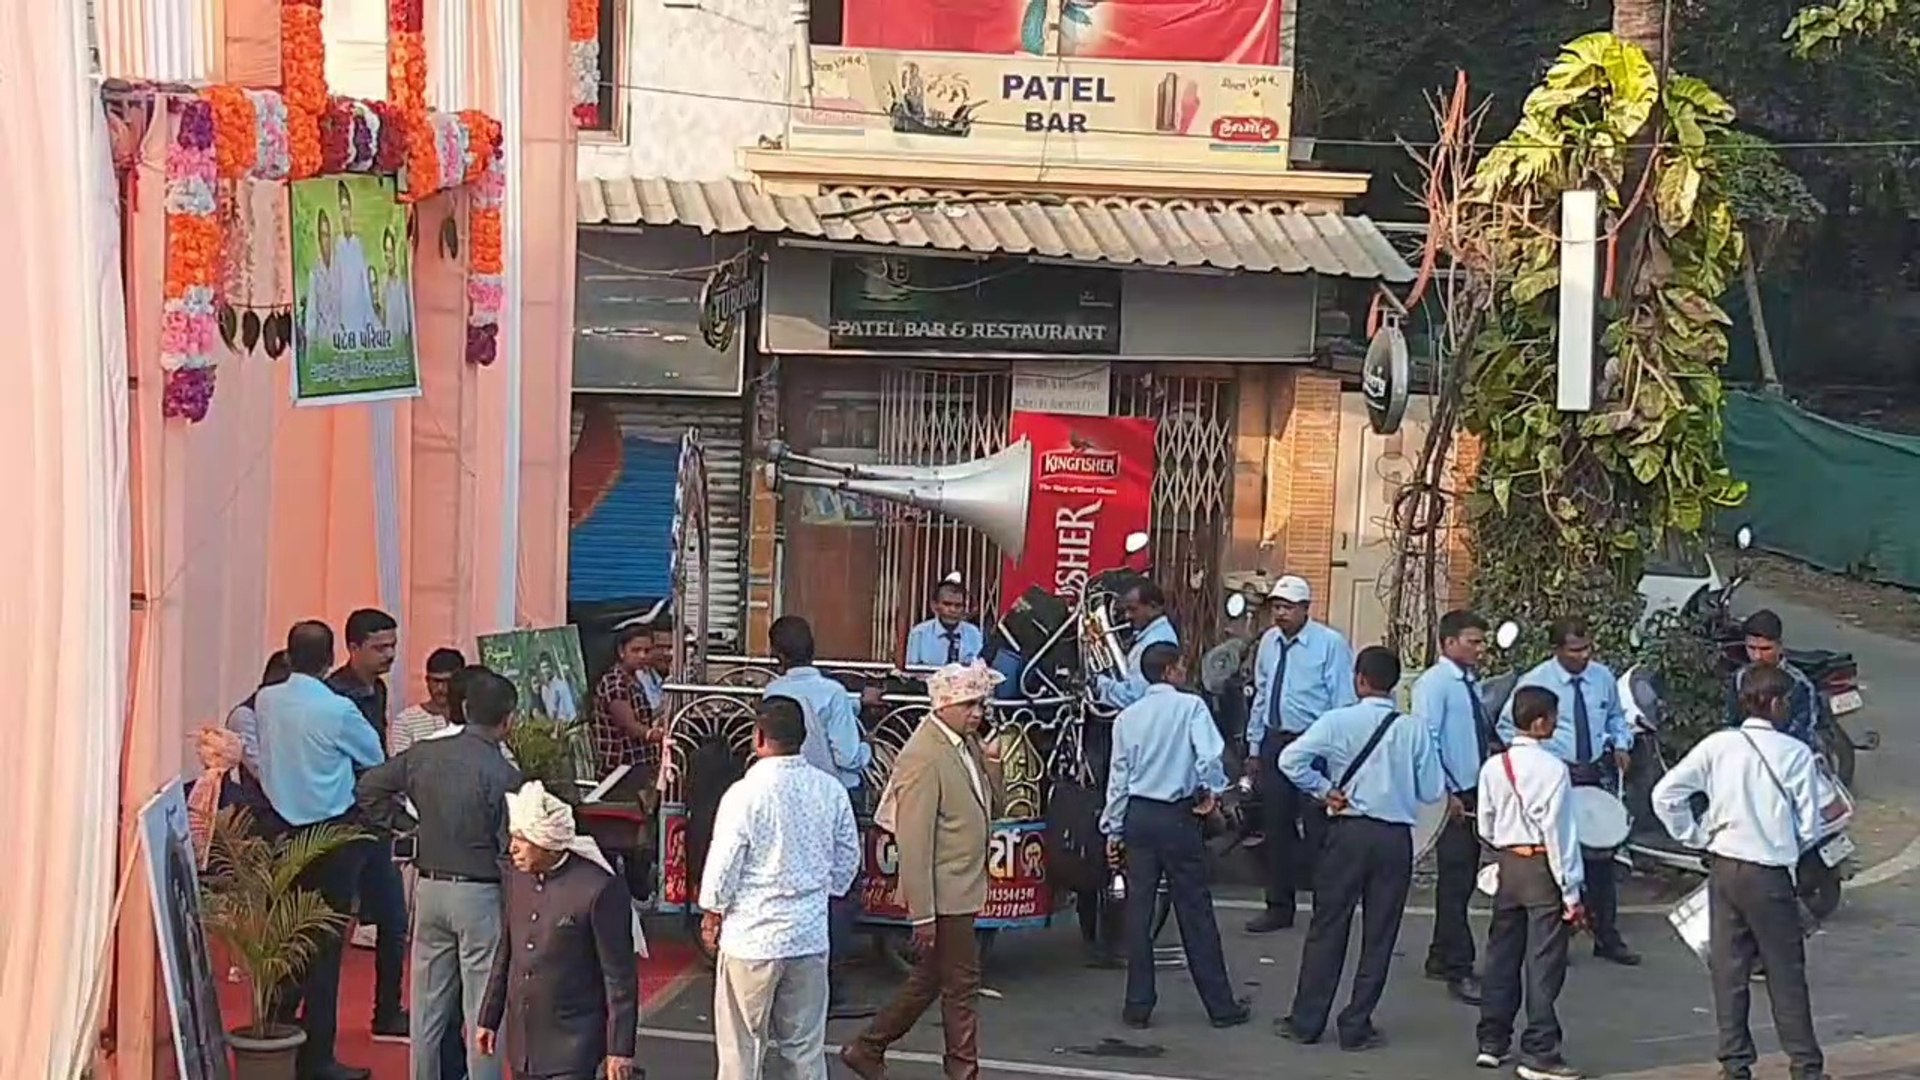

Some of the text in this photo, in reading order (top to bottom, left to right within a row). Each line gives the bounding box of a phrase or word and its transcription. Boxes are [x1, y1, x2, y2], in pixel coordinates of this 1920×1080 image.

[1002, 74, 1116, 104] PATEL
[1024, 111, 1087, 133] BAR
[838, 321, 1107, 341] PATEL BAR & RESTAURANT
[1044, 453, 1115, 475] KINGFISHER
